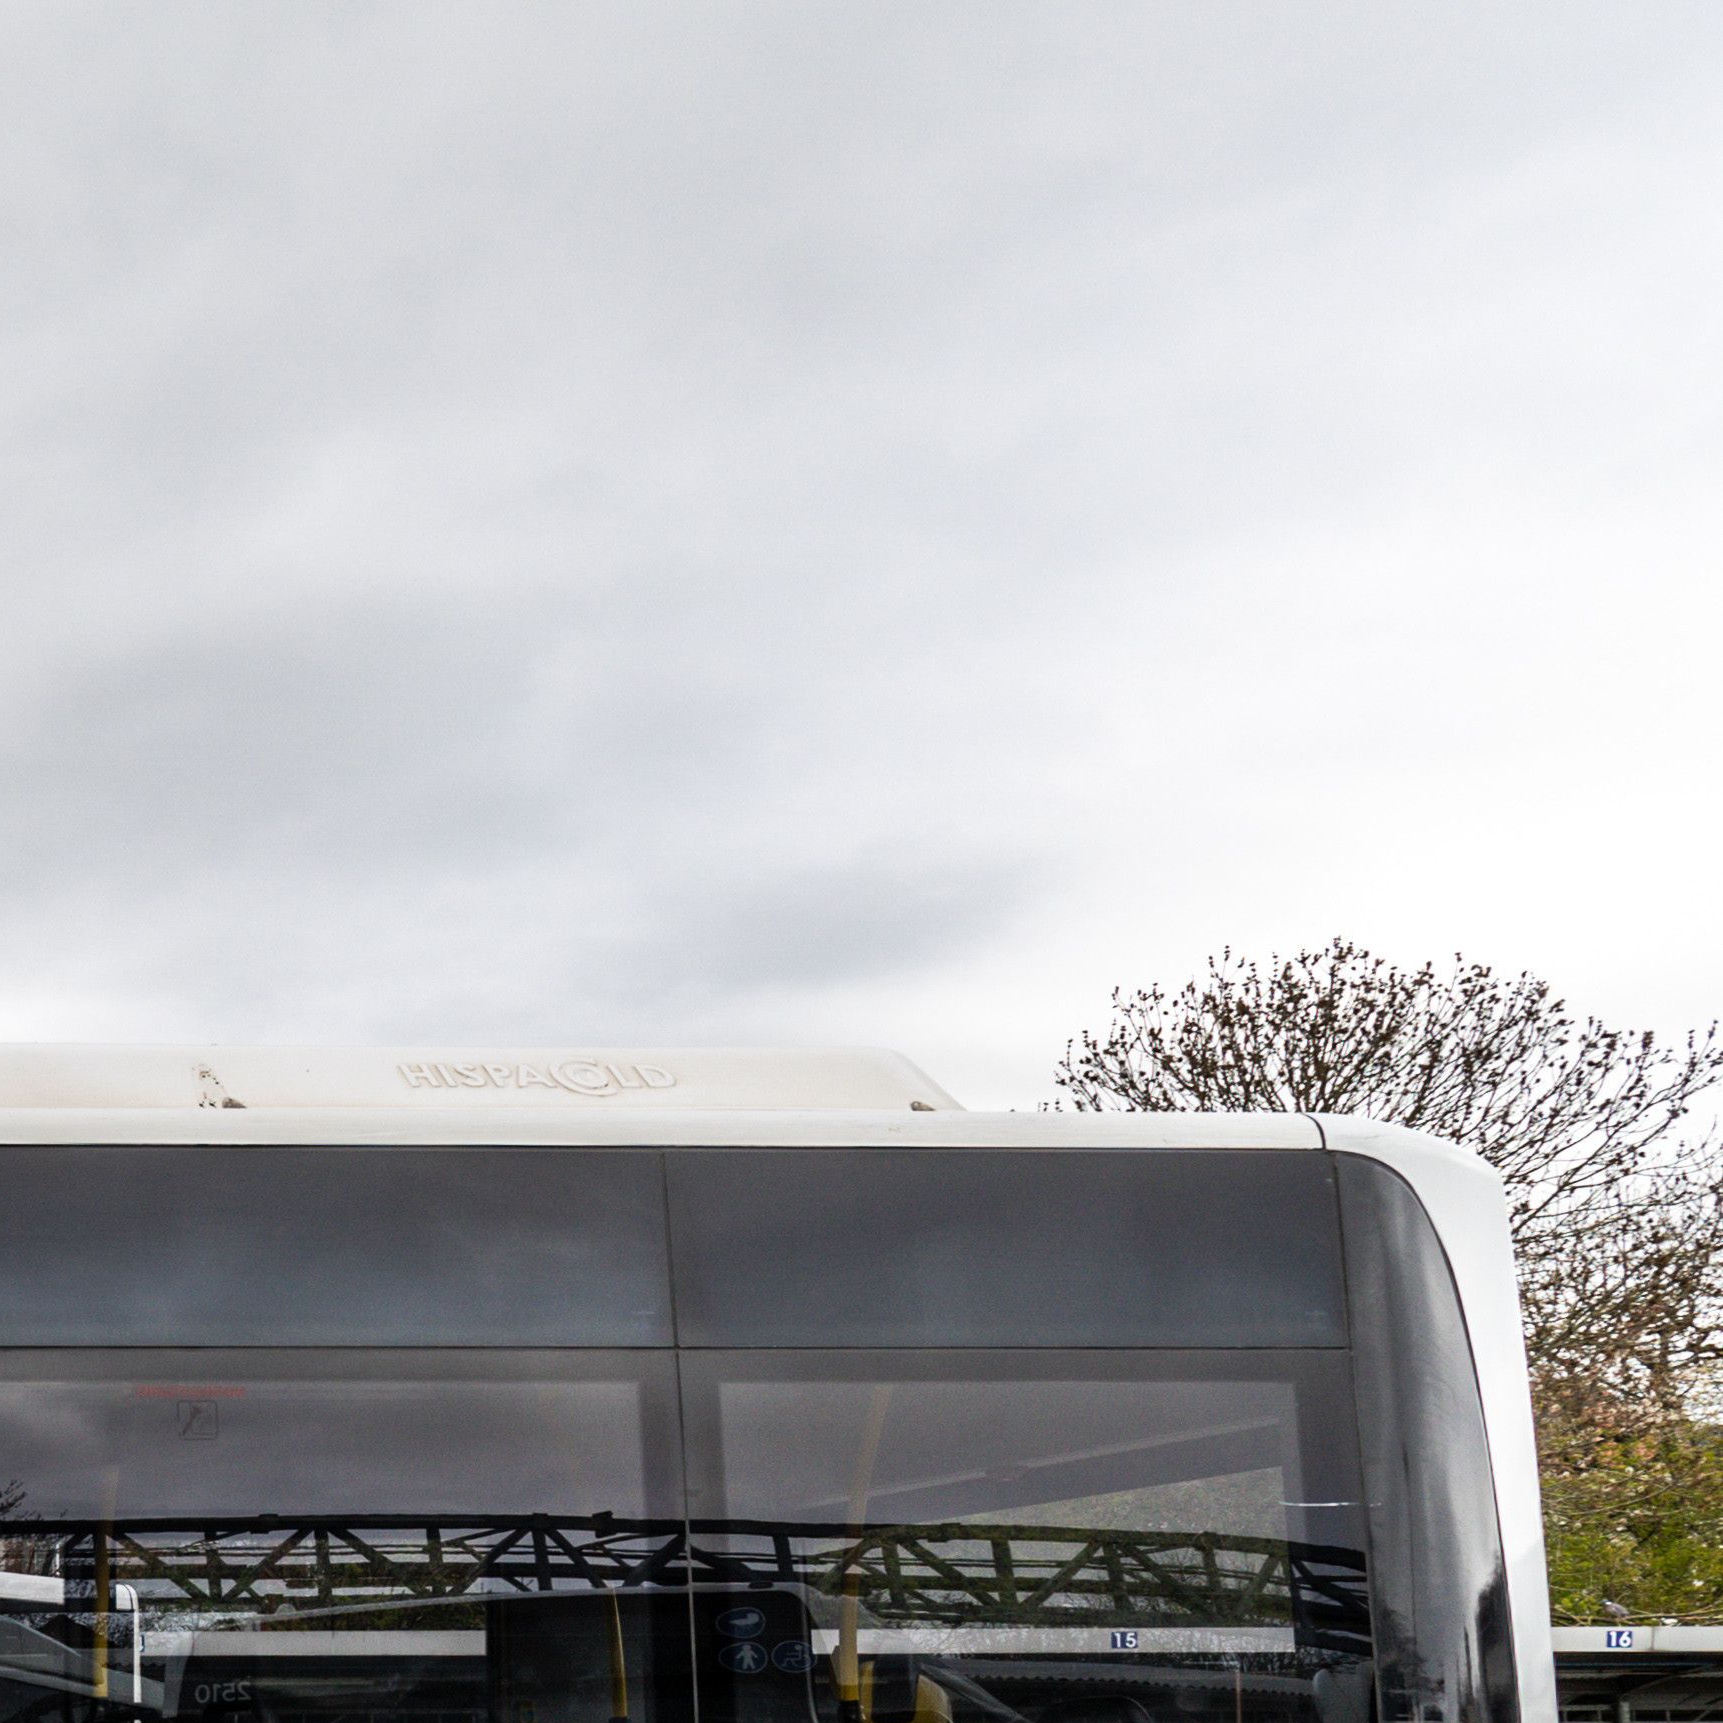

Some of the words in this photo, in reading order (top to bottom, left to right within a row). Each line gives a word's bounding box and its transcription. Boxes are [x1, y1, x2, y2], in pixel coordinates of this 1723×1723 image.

[397, 1057, 678, 1097] HISPACOLD
[1114, 1631, 1137, 1649] 15
[1609, 1630, 1632, 1648] 16
